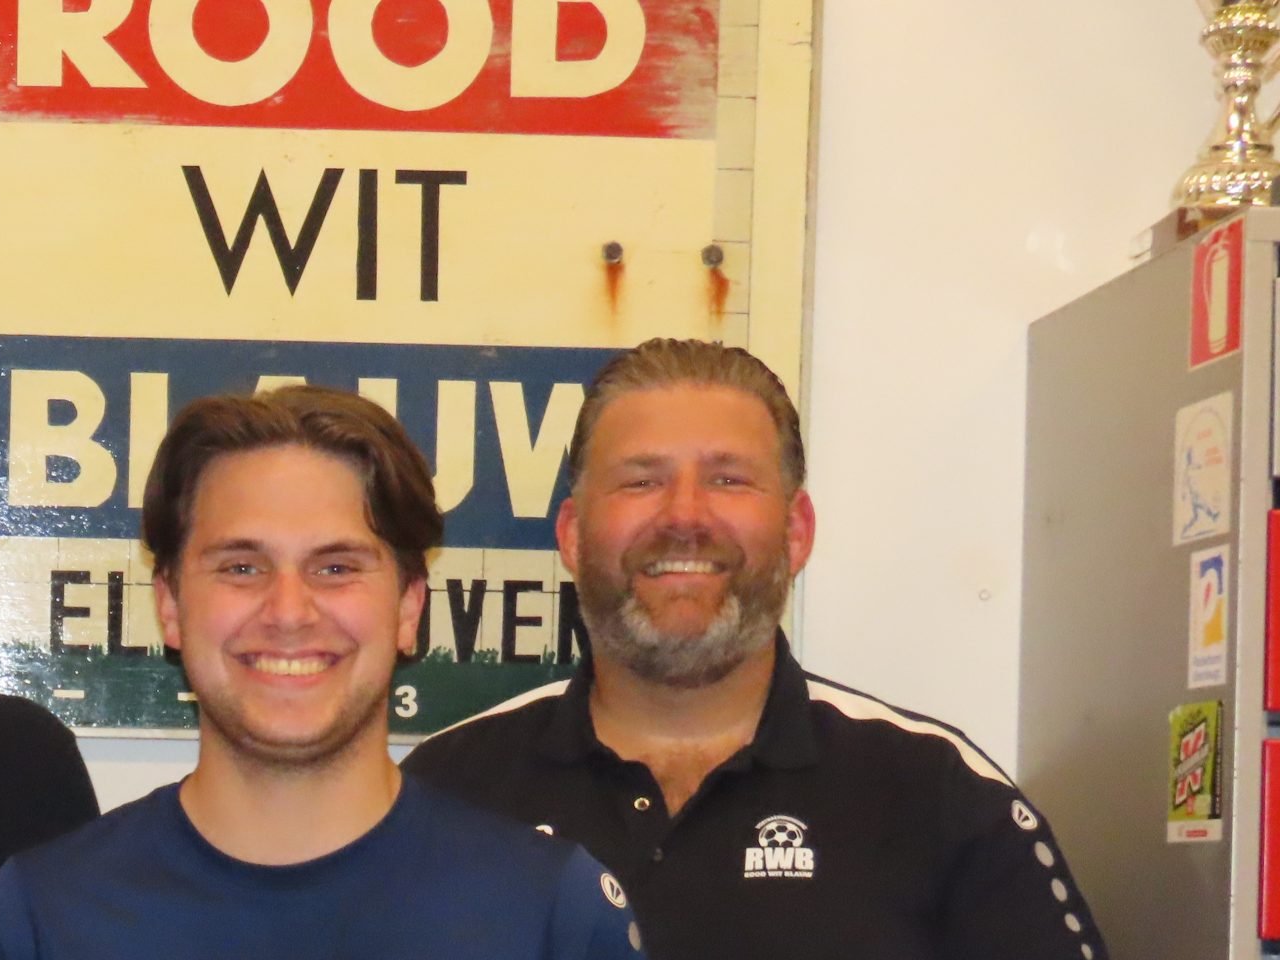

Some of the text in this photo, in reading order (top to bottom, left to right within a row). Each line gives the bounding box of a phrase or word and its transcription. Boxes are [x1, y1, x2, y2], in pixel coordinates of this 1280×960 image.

[17, 0, 646, 111] ROOD
[181, 165, 468, 302] WIT
[8, 369, 586, 518] BLUW
[744, 847, 815, 871] RWB
